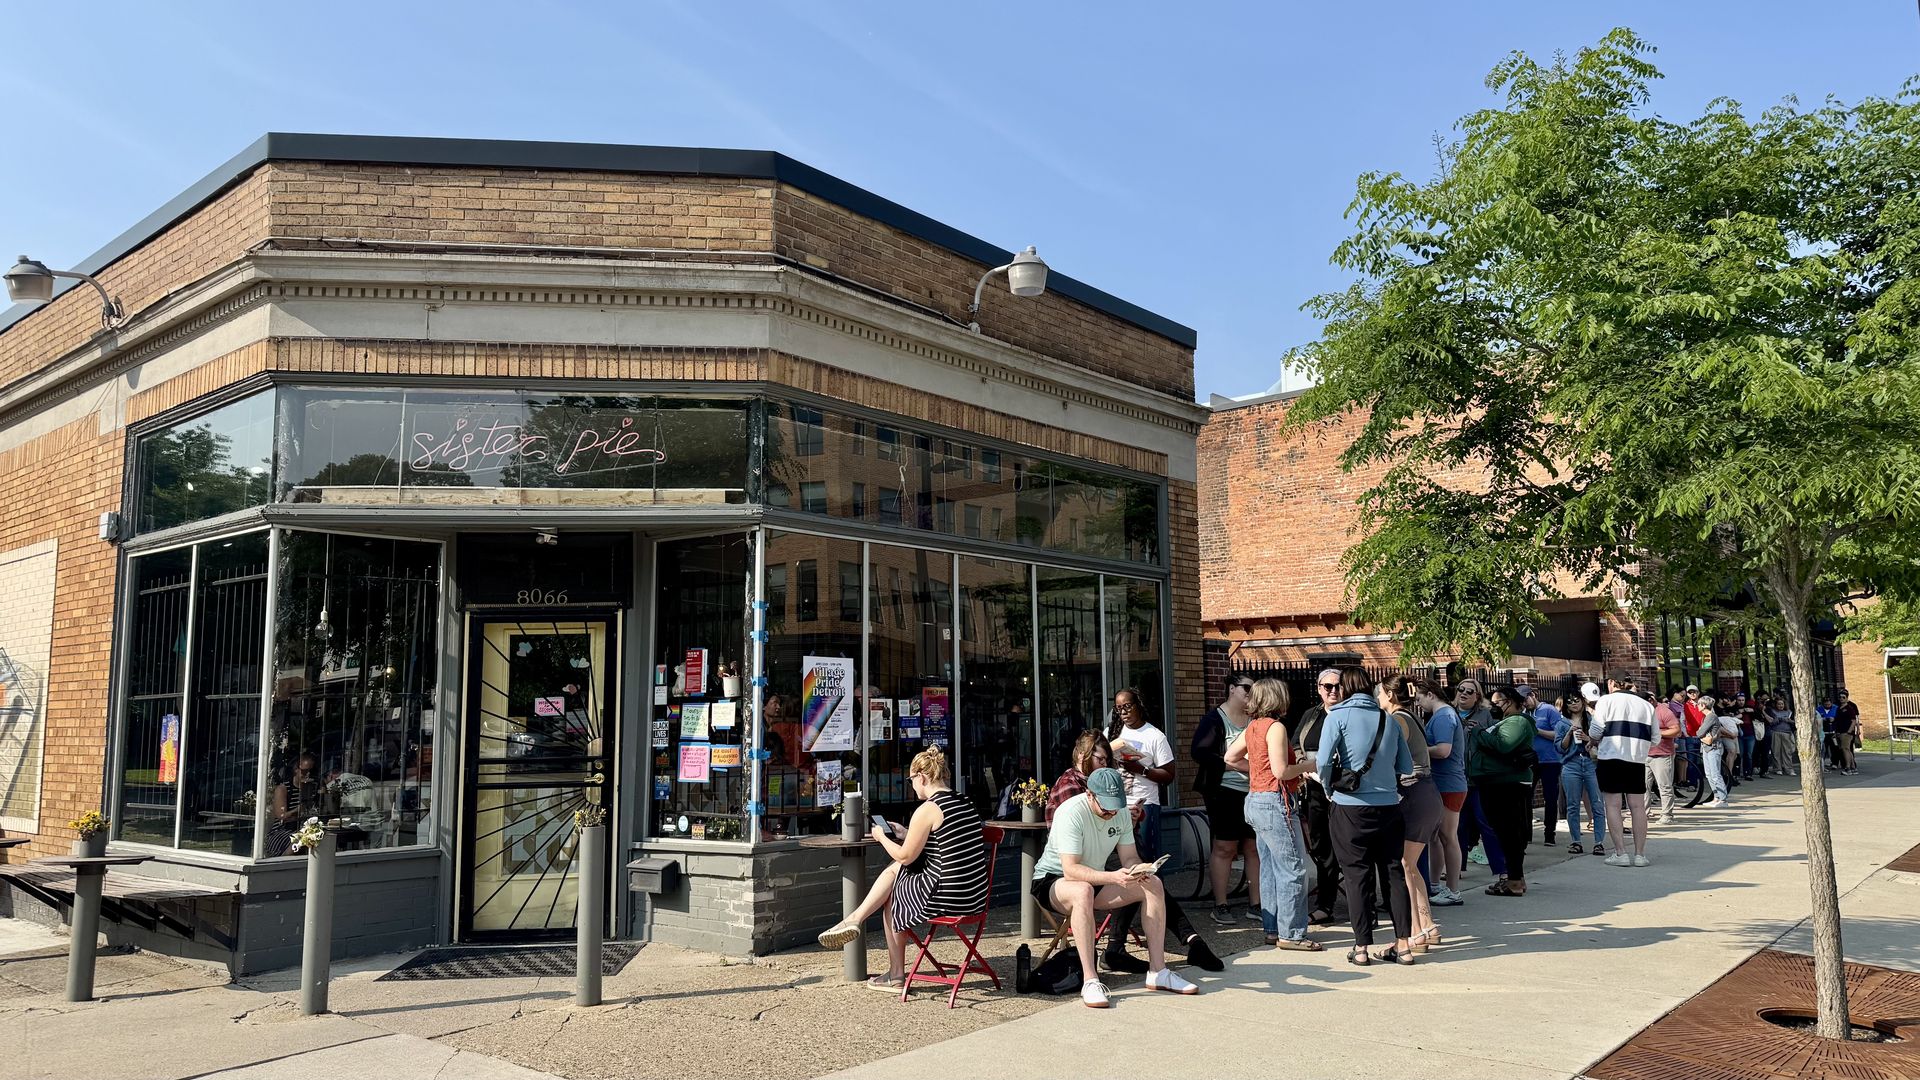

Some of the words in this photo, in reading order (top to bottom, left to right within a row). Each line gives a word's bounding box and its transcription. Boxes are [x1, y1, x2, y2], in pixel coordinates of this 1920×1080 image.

[411, 418, 547, 470] sister
[557, 417, 665, 473] pie
[517, 588, 568, 605] 8066
[812, 666, 846, 678] Village
[815, 677, 841, 688] Pride
[812, 687, 846, 697] Detroit
[653, 721, 669, 730] BLACK
[654, 730, 667, 738] LIVES
